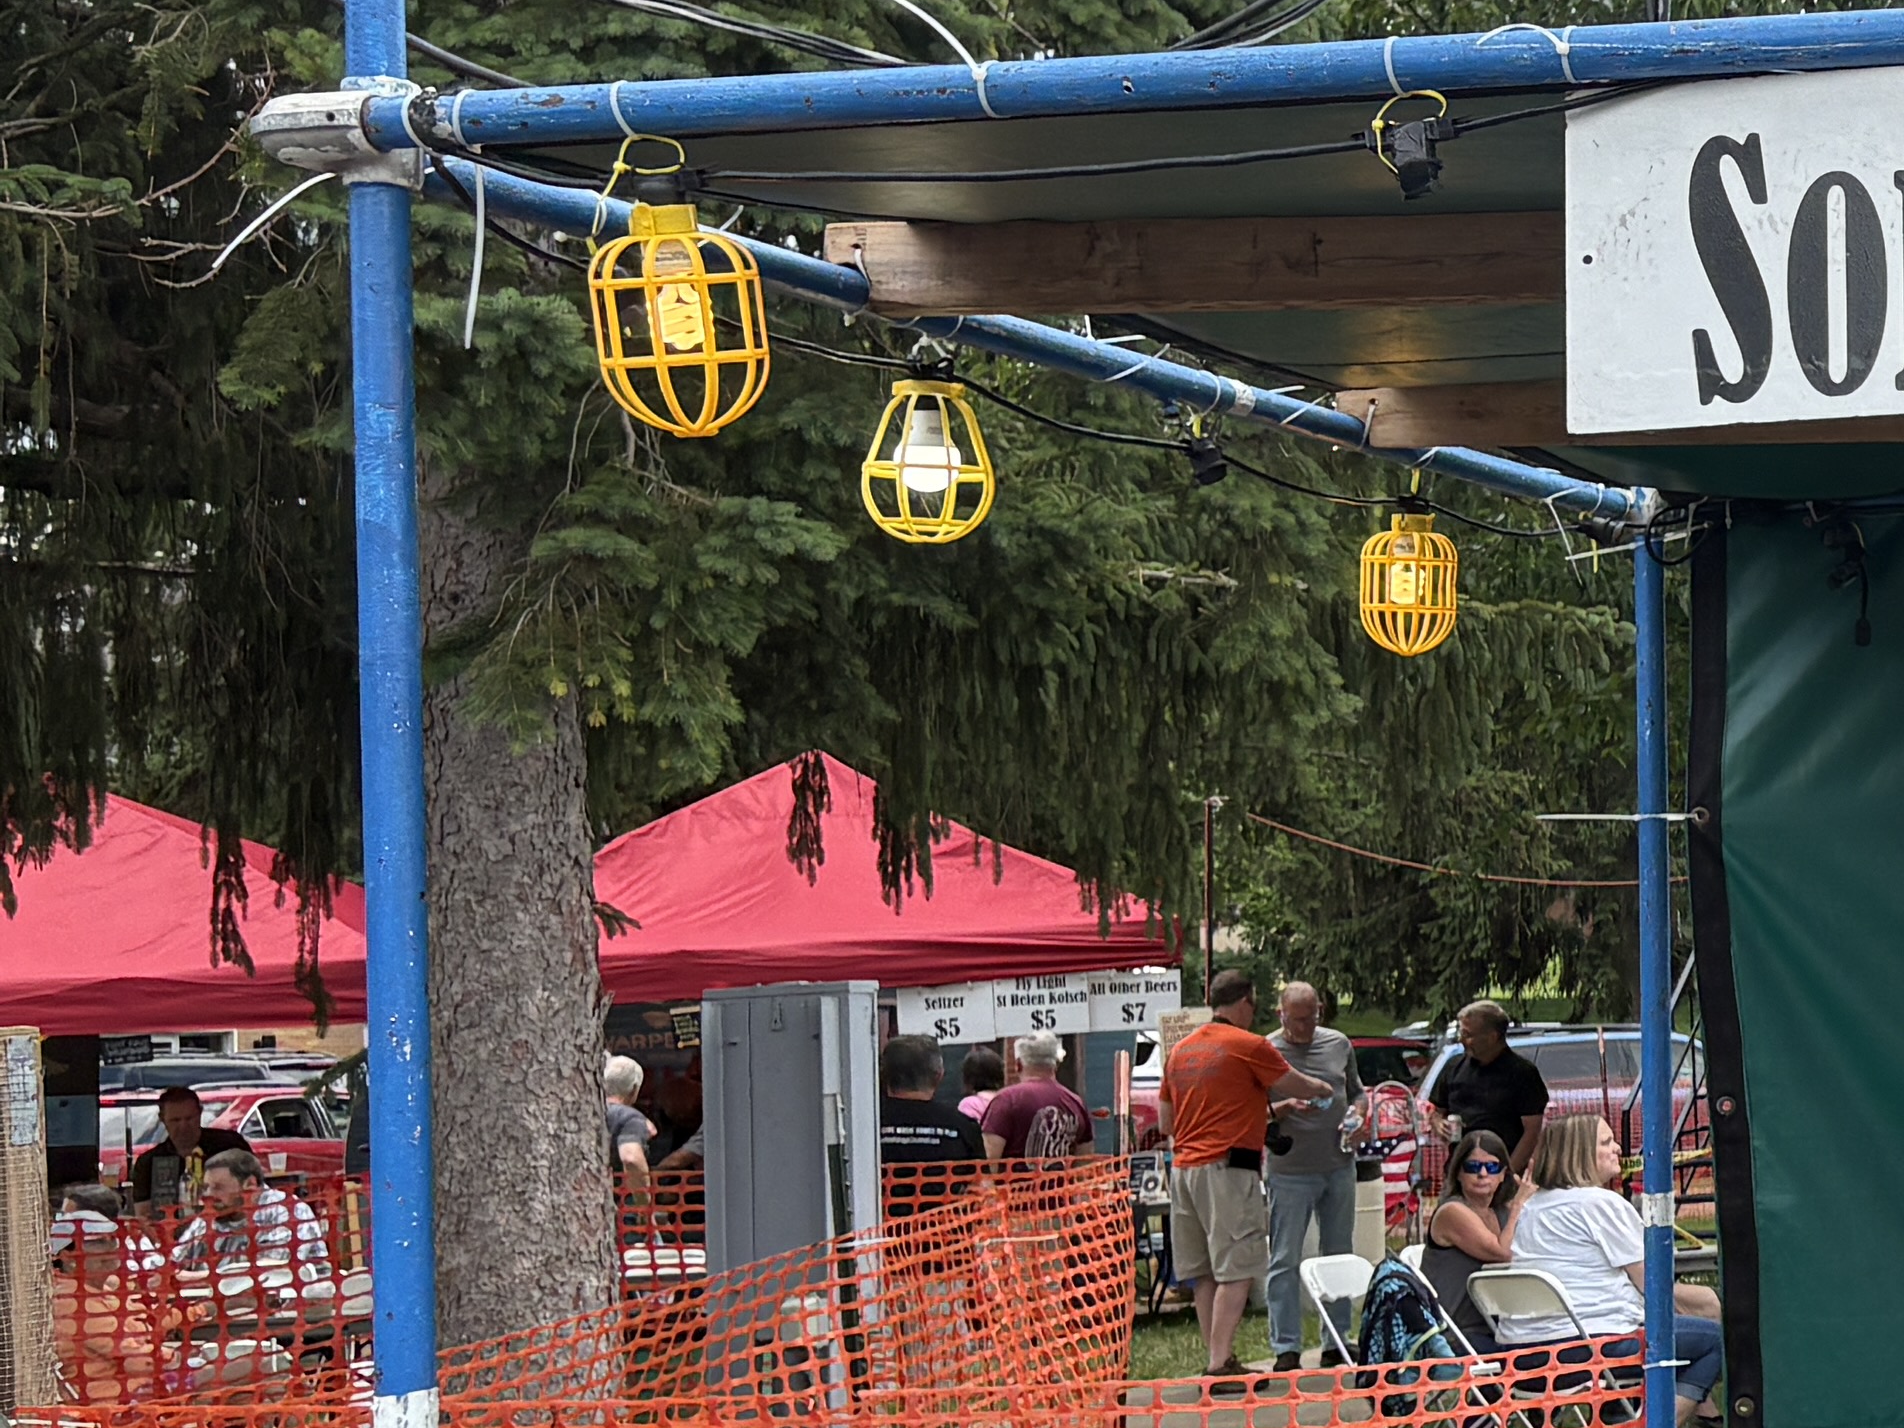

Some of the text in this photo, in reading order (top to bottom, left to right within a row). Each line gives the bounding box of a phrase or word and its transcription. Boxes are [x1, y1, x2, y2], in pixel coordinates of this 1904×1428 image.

[1090, 979, 1178, 996] All Other Beers
[924, 996, 965, 1010] Seltzer
[1121, 1002, 1147, 1023] $7
[934, 1018, 961, 1040] $5
[1030, 1009, 1057, 1031] $5
